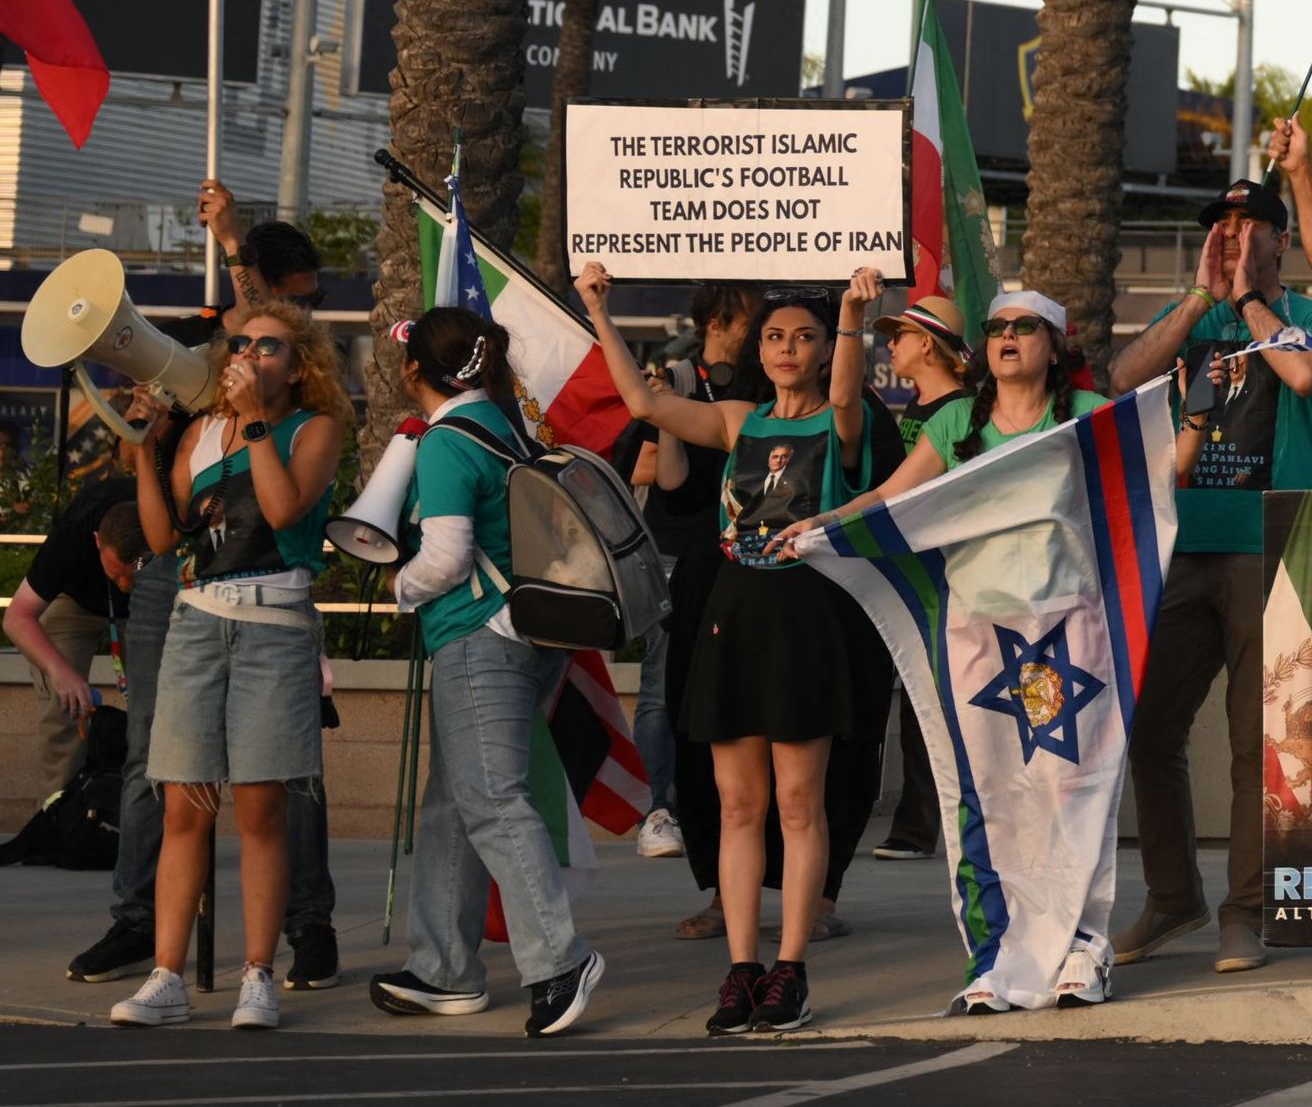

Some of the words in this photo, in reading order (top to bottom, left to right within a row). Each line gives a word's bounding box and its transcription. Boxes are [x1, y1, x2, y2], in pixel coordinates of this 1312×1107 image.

[610, 136, 646, 156] THE
[650, 134, 766, 156] TERRORIST
[772, 133, 858, 155] ISLAMIC
[619, 168, 733, 189] REPUBLIC'S
[740, 166, 849, 187] FOOTBALL
[650, 200, 707, 221] TEAM
[713, 199, 769, 220] DOES
[776, 199, 821, 219] NOT
[572, 233, 681, 254] REPRESENT
[686, 232, 724, 253] THE
[731, 231, 808, 253] PEOPLE
[814, 231, 842, 252] OF
[849, 231, 902, 252] IRAN
